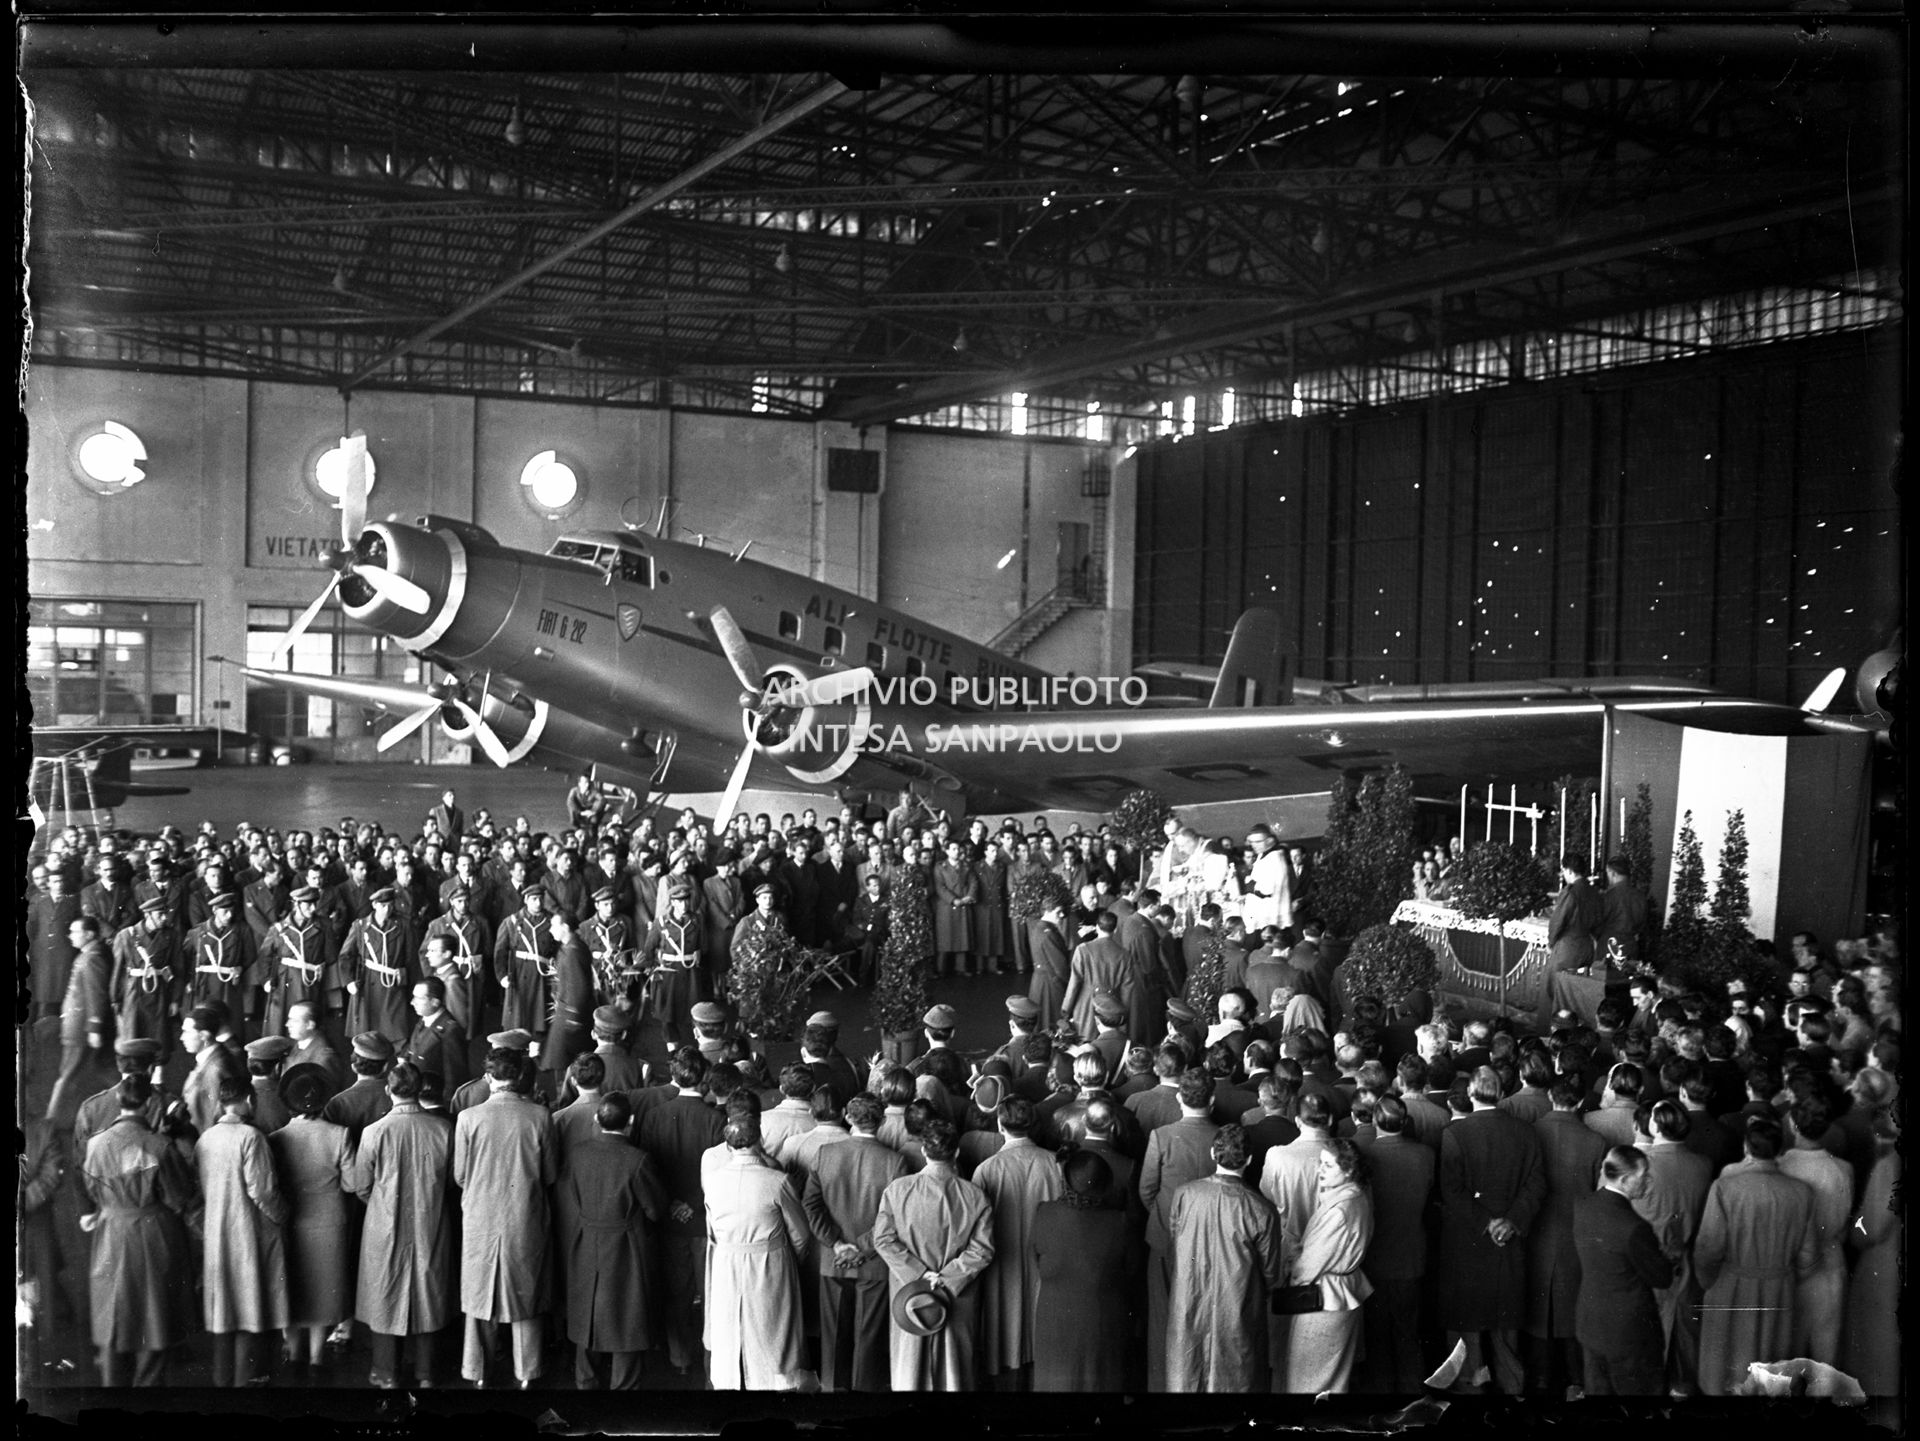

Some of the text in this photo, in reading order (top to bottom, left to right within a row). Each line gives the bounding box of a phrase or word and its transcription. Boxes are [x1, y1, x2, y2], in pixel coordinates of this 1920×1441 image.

[537, 608, 559, 636] FIAT
[570, 619, 588, 644] 212
[874, 618, 952, 666] FLOTTE
